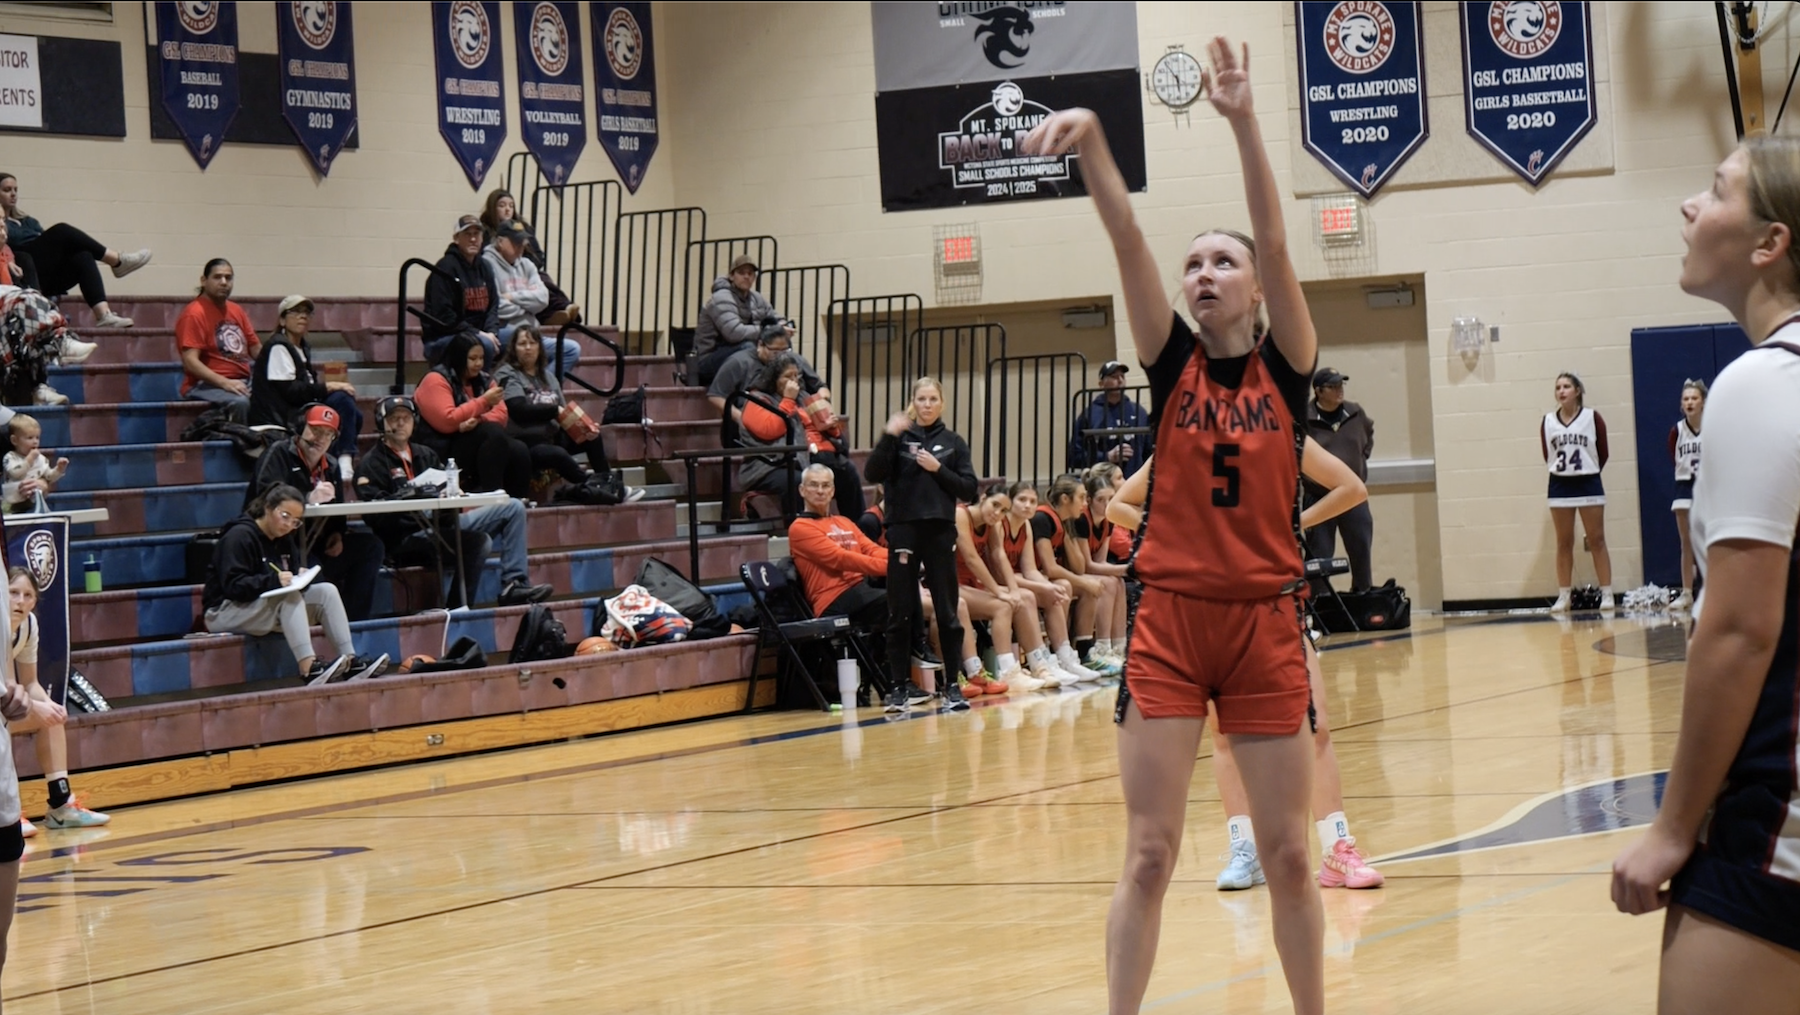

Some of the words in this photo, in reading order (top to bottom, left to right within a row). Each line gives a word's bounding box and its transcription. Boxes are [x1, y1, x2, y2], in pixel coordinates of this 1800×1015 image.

[940, 18, 965, 28] SMALL
[1032, 8, 1065, 18] SCHOOLS
[1340, 1, 1392, 30] SPOKANE
[1498, 28, 1555, 54] WILDCATS
[1333, 43, 1388, 70] WILDCATS
[180, 71, 222, 86] BASEBALL
[1473, 70, 1499, 87] GSL
[1502, 62, 1584, 84] CHAMPIONS
[0, 88, 35, 106] ENTS
[286, 89, 351, 110] GYMNASTICS
[1309, 85, 1335, 102] GSL
[1337, 78, 1417, 99] CHAMPIONS
[1475, 96, 1509, 110] GIRLS
[1512, 88, 1586, 107] BASKETBALL
[187, 93, 218, 109] 2019
[308, 112, 333, 129] 2019
[446, 106, 500, 126] WRESTLING
[525, 111, 582, 124] VOLLEYBALL
[1330, 105, 1398, 122] WRESTLING
[1506, 111, 1556, 130] 2020
[971, 119, 991, 133] MT.
[1342, 126, 1389, 144] 2020
[462, 128, 485, 144] 2019
[543, 132, 569, 146] 2019
[618, 136, 639, 150] 2019
[944, 132, 1002, 164] BACK
[1001, 138, 1013, 150] TO
[959, 170, 983, 182] SMALL
[985, 167, 1018, 180] SCHOOLS
[1019, 163, 1064, 176] CHAMPIONS
[987, 184, 1008, 196] 2024
[1014, 181, 1036, 193] 2025
[1176, 390, 1280, 433] BANTAMS
[1556, 449, 1582, 472] 34
[1212, 443, 1240, 508] 5
